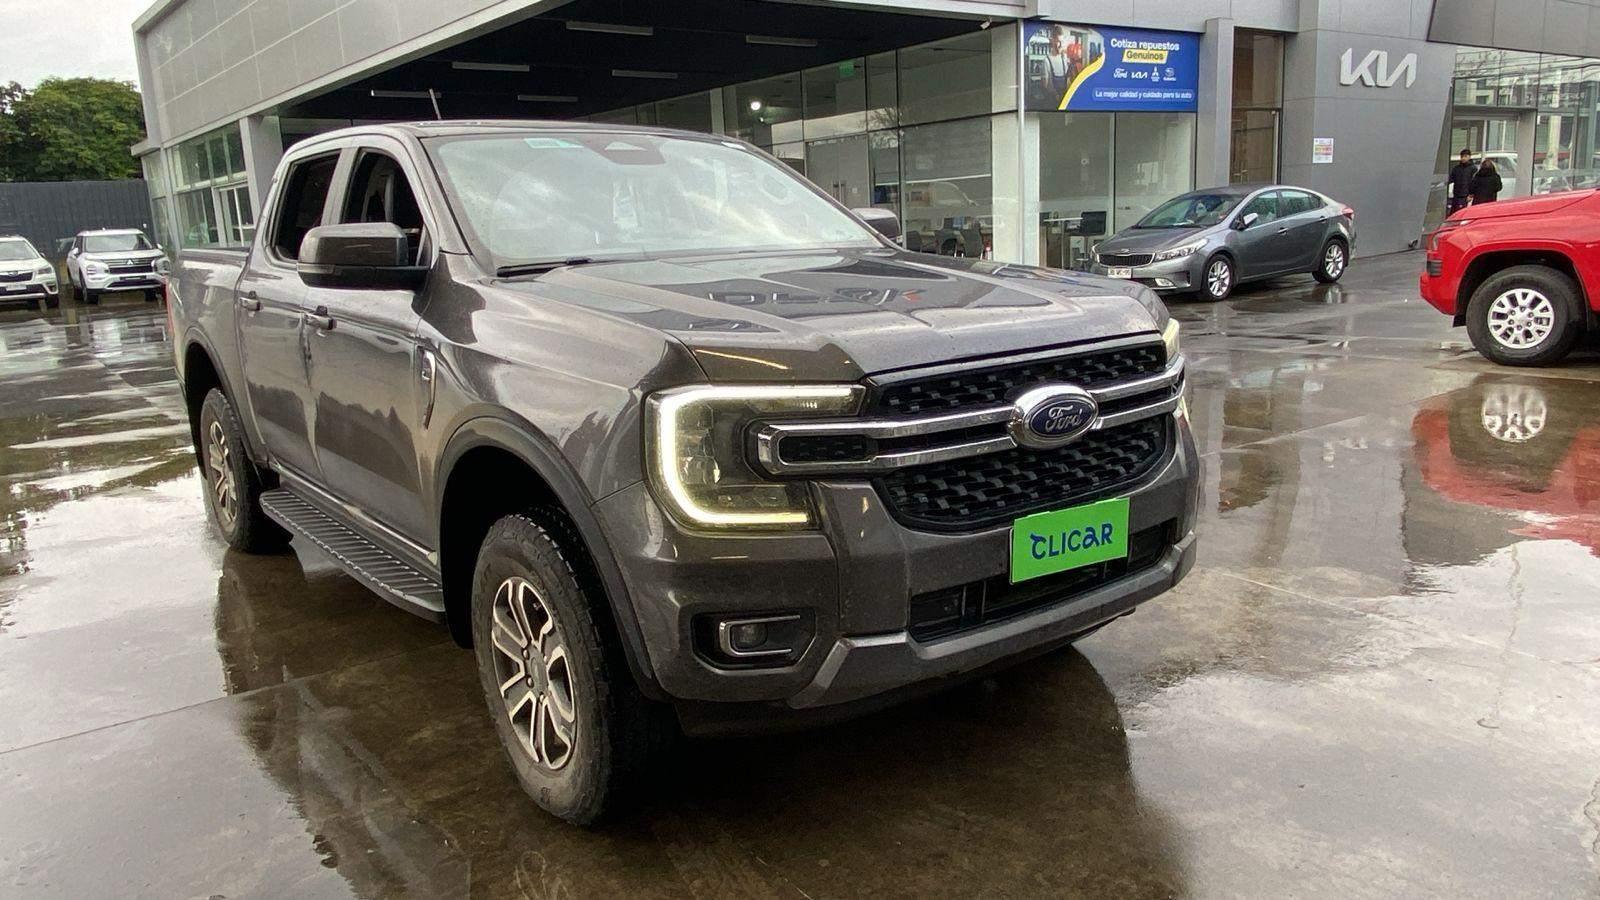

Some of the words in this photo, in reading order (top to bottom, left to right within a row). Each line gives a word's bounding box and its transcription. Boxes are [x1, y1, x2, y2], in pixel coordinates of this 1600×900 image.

[1111, 38, 1137, 48] Cotiza
[1139, 41, 1180, 50] repuestos
[1126, 50, 1164, 60] Genuinos
[1114, 68, 1128, 78] Ford
[1340, 48, 1418, 88] KIA
[1095, 90, 1103, 98] La
[1103, 91, 1119, 99] mejor
[1045, 405, 1083, 432] Ford
